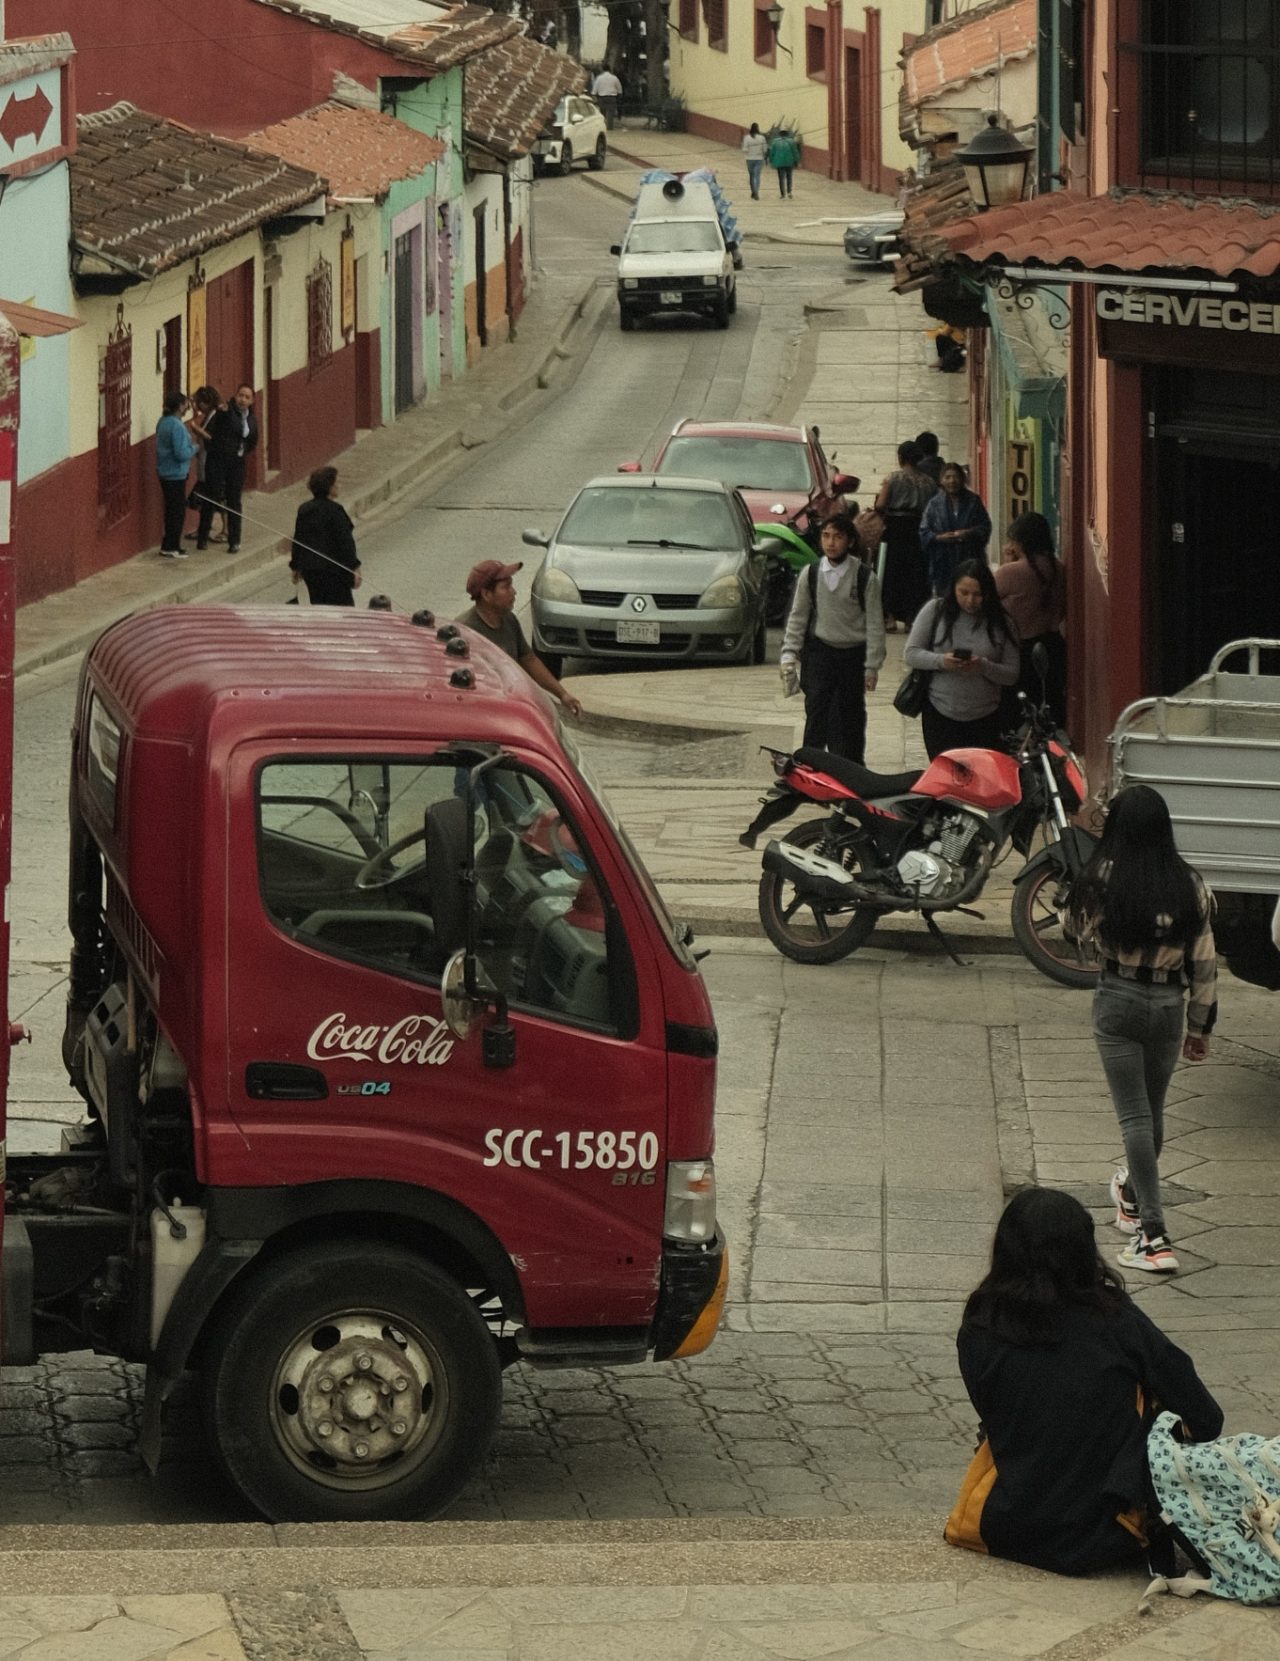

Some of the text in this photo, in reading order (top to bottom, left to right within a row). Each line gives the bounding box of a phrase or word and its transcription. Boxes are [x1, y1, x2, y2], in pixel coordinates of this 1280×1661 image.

[1096, 289, 1280, 334] CERVECE
[306, 1012, 455, 1065] Coca-Cola
[483, 1128, 659, 1170] SCC-15850
